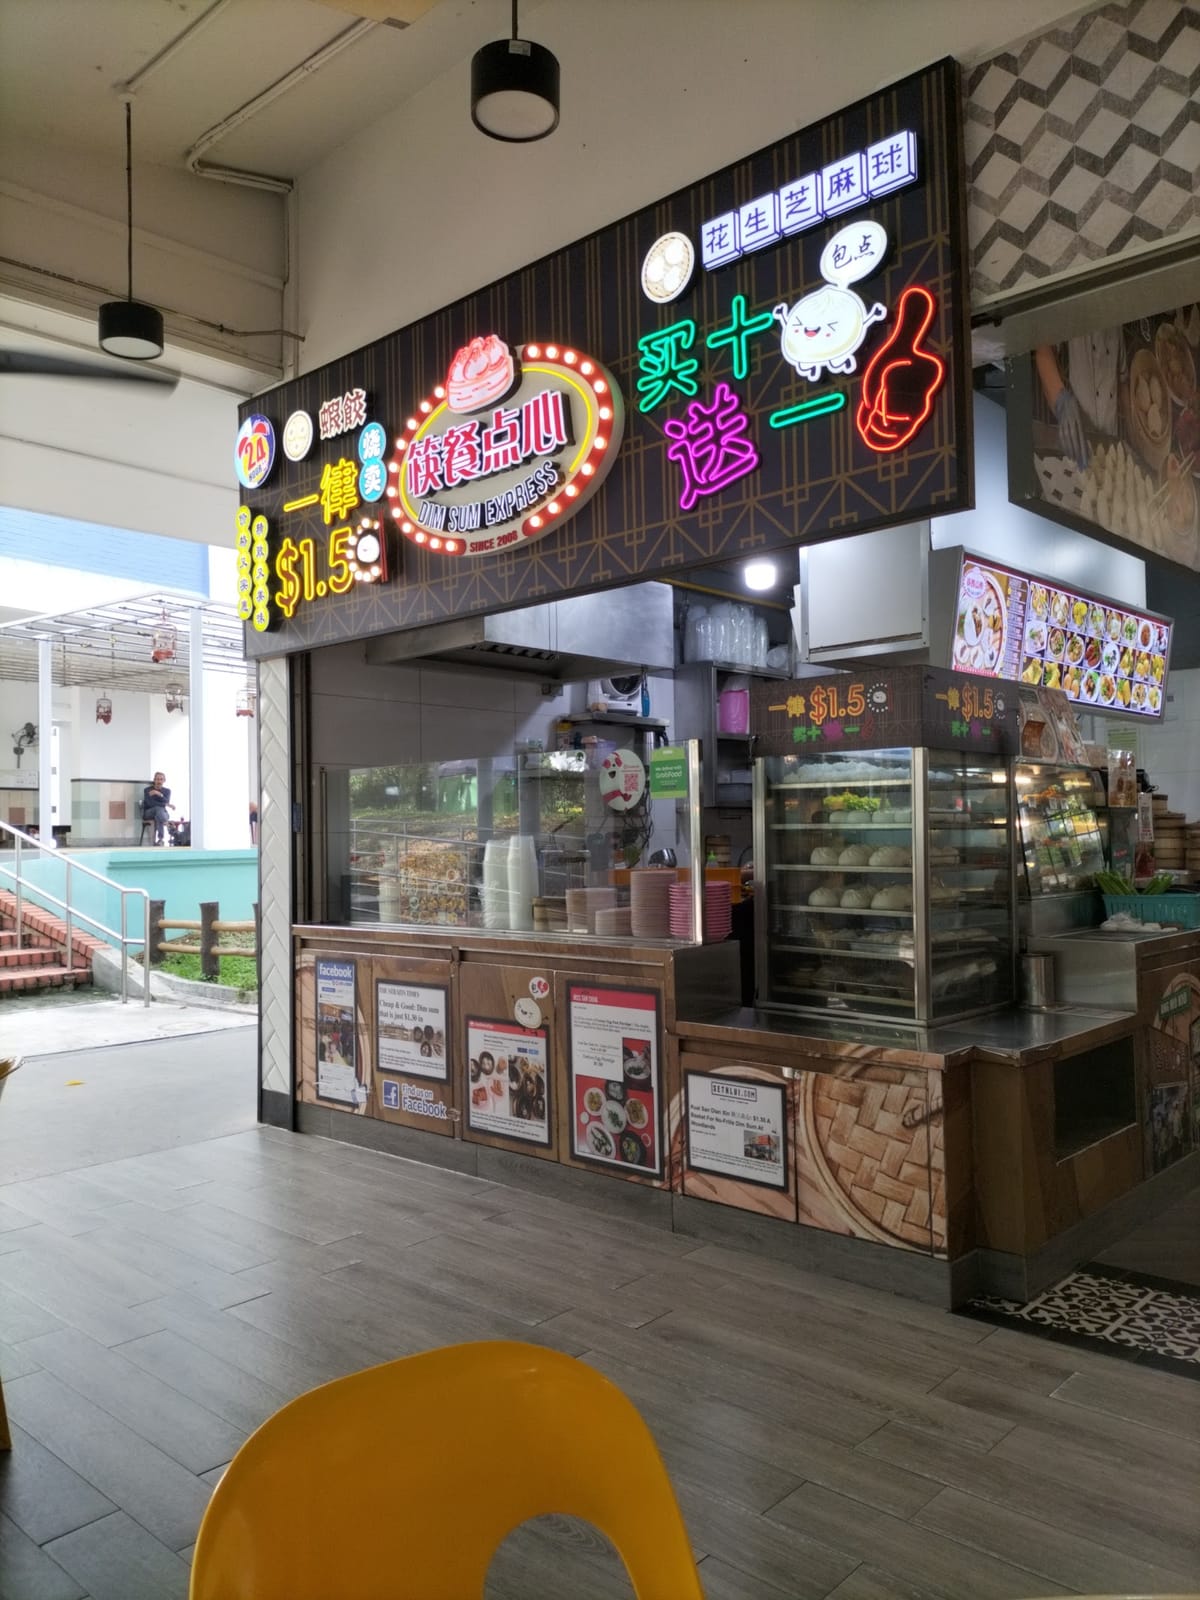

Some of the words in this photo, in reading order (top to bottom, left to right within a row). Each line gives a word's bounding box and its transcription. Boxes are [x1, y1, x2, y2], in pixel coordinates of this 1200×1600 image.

[705, 143, 904, 254] 花生芝麻球
[831, 234, 876, 269] 包点
[638, 294, 775, 413] 买十
[318, 388, 368, 440] 蝦餃
[245, 436, 266, 471] 24
[407, 389, 568, 498] 筷餐点心
[664, 382, 846, 511] 送一
[417, 500, 446, 530] DIM
[448, 502, 481, 533] SUM
[484, 460, 559, 527] EXPRESS
[470, 538, 495, 553] SINCE
[275, 526, 354, 618] $1.5
[809, 684, 865, 725] $1.5
[961, 682, 994, 722] $1.5
[319, 963, 353, 978] facebook
[402, 1083, 416, 1096] Find
[416, 1088, 424, 1098] us
[424, 1090, 433, 1100] on
[402, 1096, 447, 1118] Facebook
